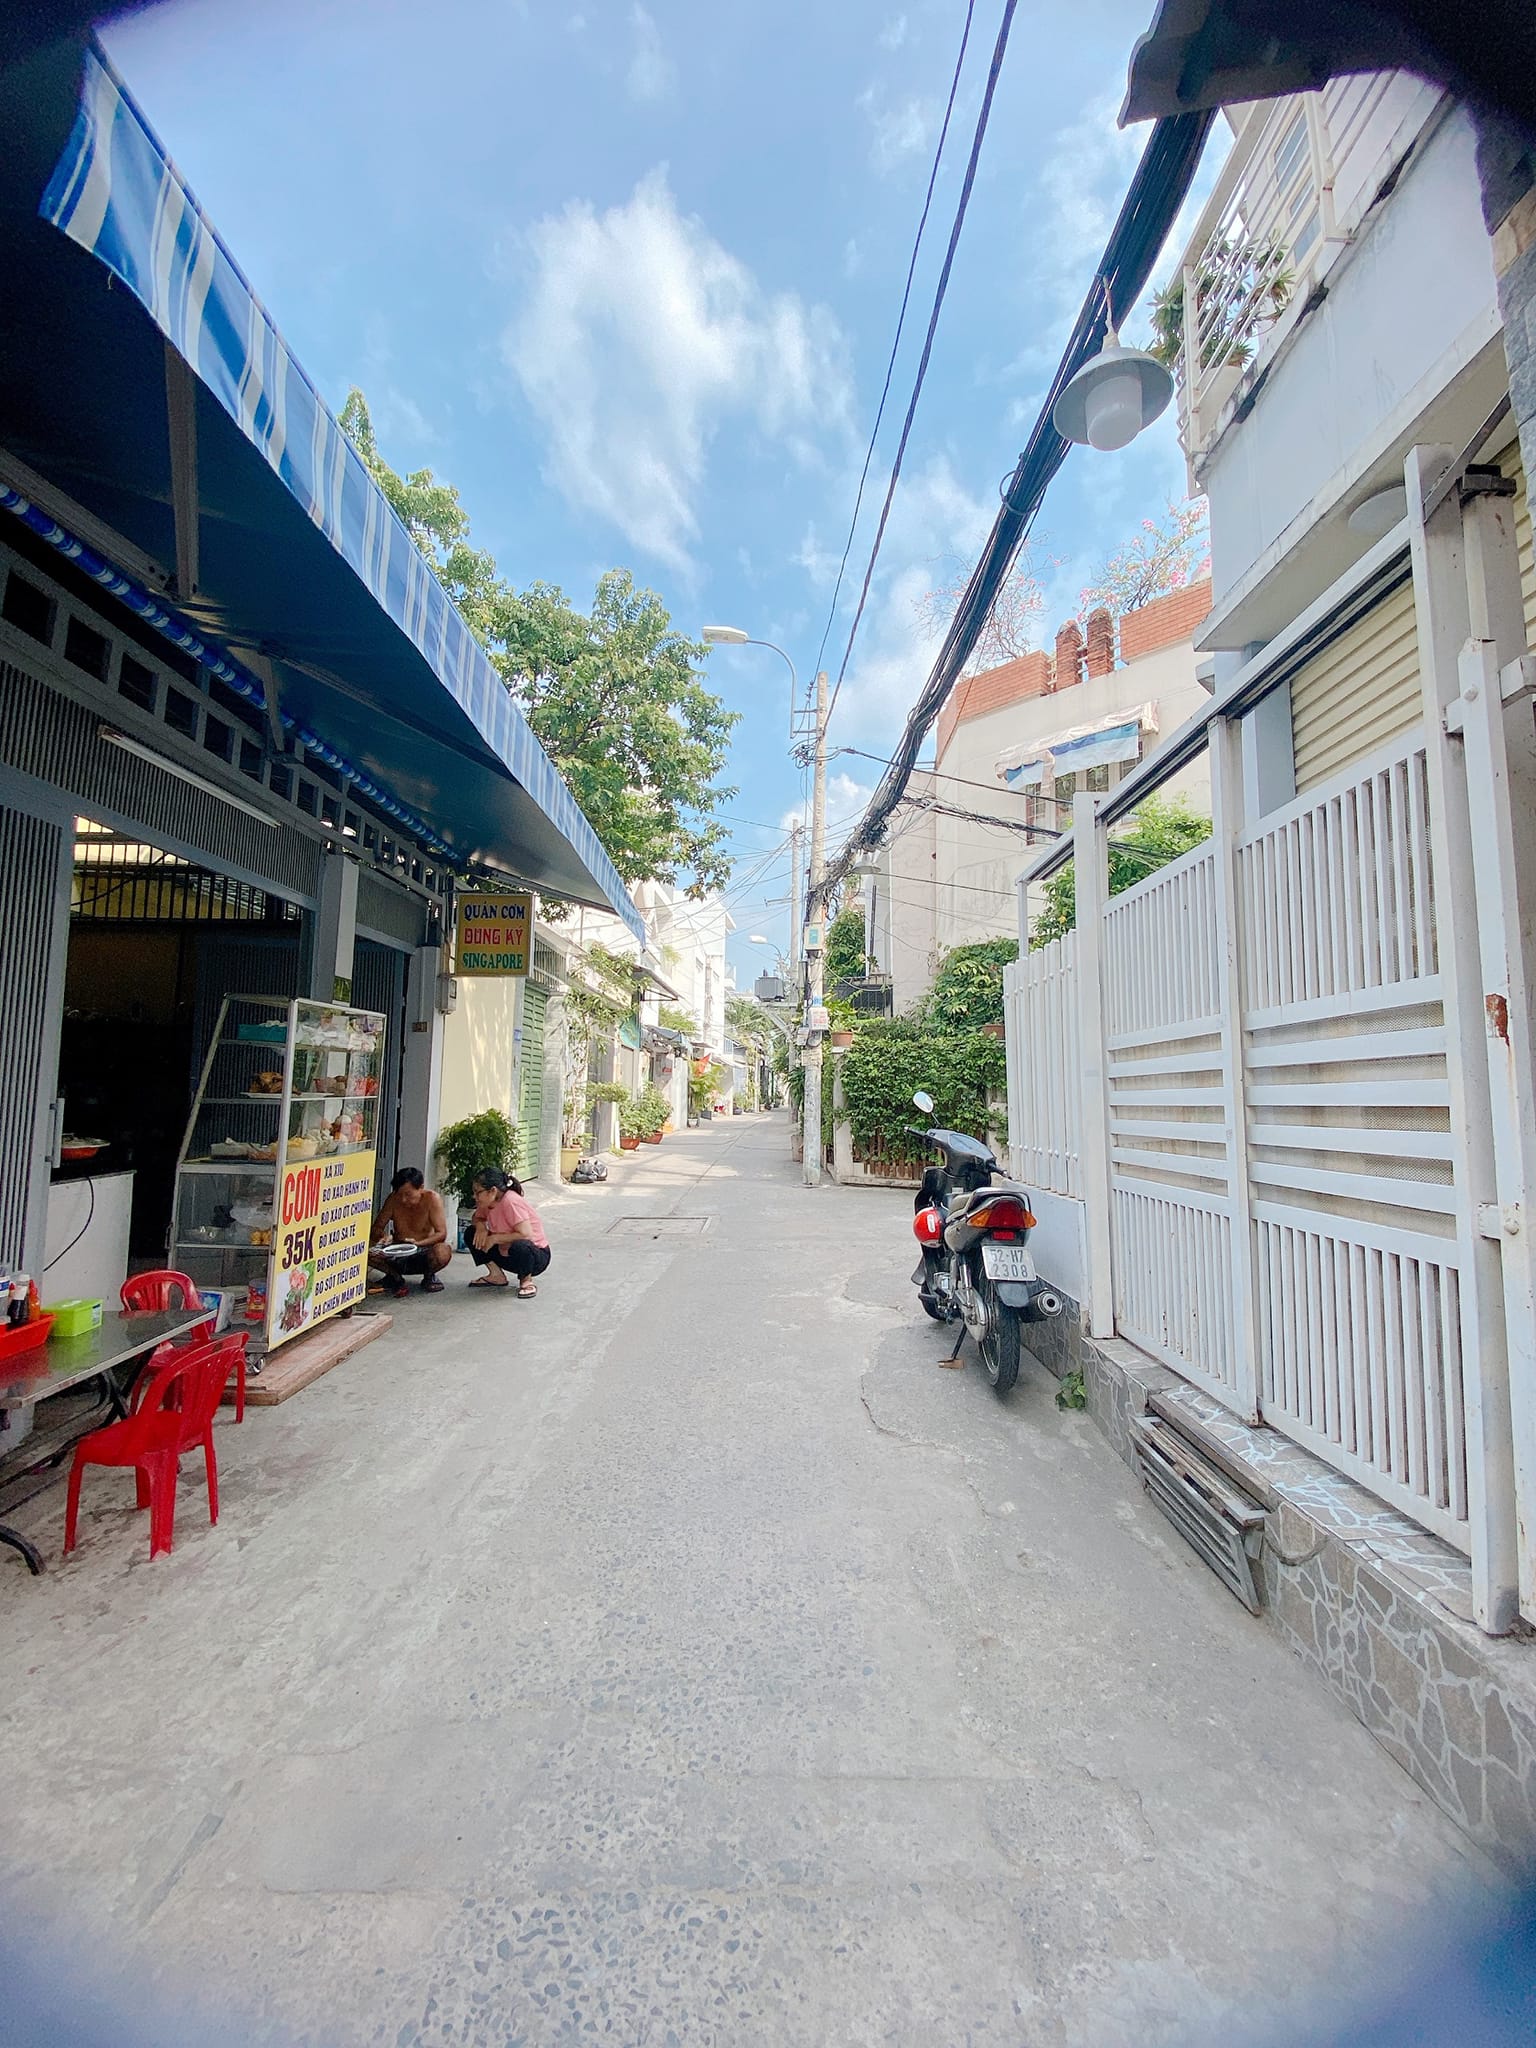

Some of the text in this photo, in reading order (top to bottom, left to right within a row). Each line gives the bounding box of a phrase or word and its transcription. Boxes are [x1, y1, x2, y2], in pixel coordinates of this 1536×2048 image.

[464, 901, 525, 921] QUÁN CƠM
[505, 925, 523, 945] KÝ
[463, 952, 523, 969] SINGAPORE
[282, 1165, 322, 1226] CƠM
[281, 1226, 316, 1270] 35K
[992, 1263, 1028, 1278] 2308
